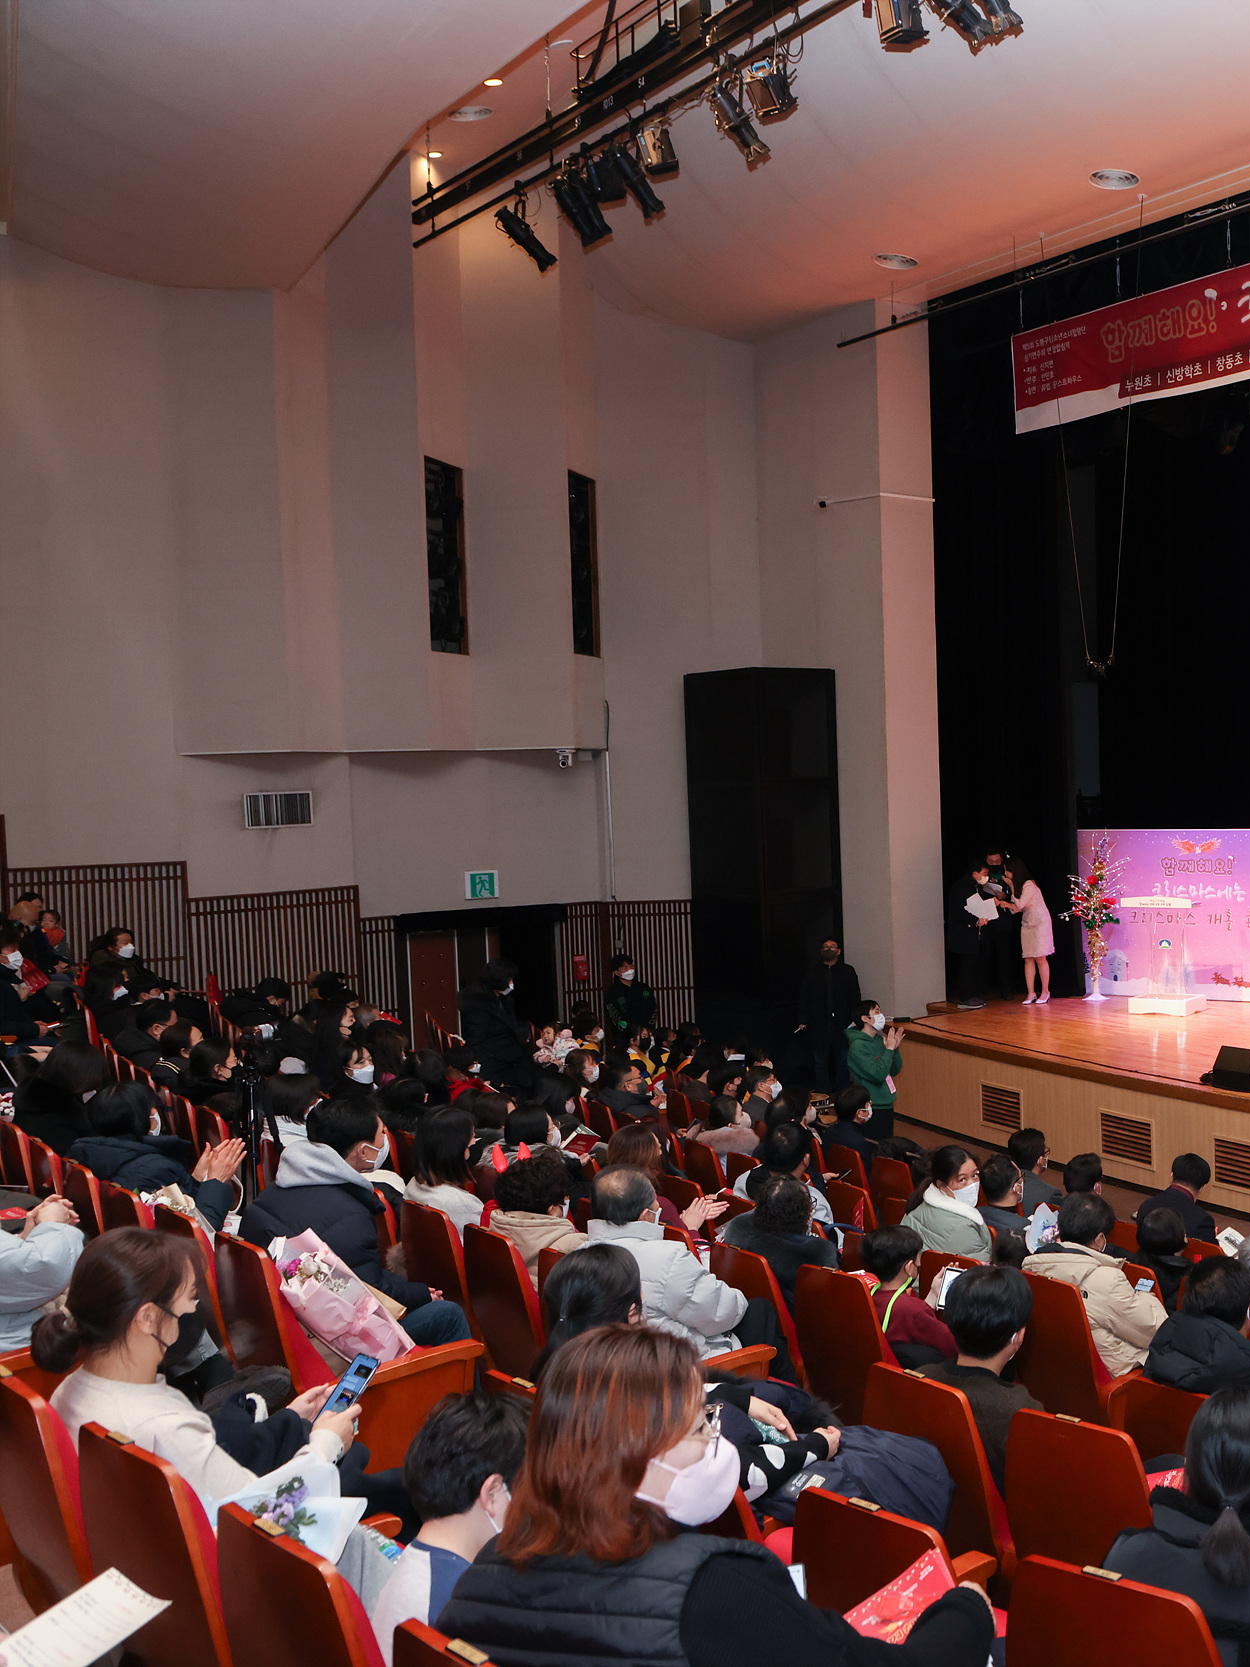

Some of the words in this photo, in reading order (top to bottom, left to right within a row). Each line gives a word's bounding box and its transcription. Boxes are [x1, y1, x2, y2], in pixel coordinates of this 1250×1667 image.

[1100, 296, 1218, 364] 함께해요!
[1124, 375, 1152, 392] 누원초
[1166, 363, 1203, 384] 신방학초
[1216, 351, 1243, 372] 창동초
[1160, 856, 1233, 877] 함께해요!
[1152, 880, 1246, 902] 크리스마스에는
[1129, 911, 1196, 926] 크리스마스
[1207, 908, 1234, 931] 캐롤
